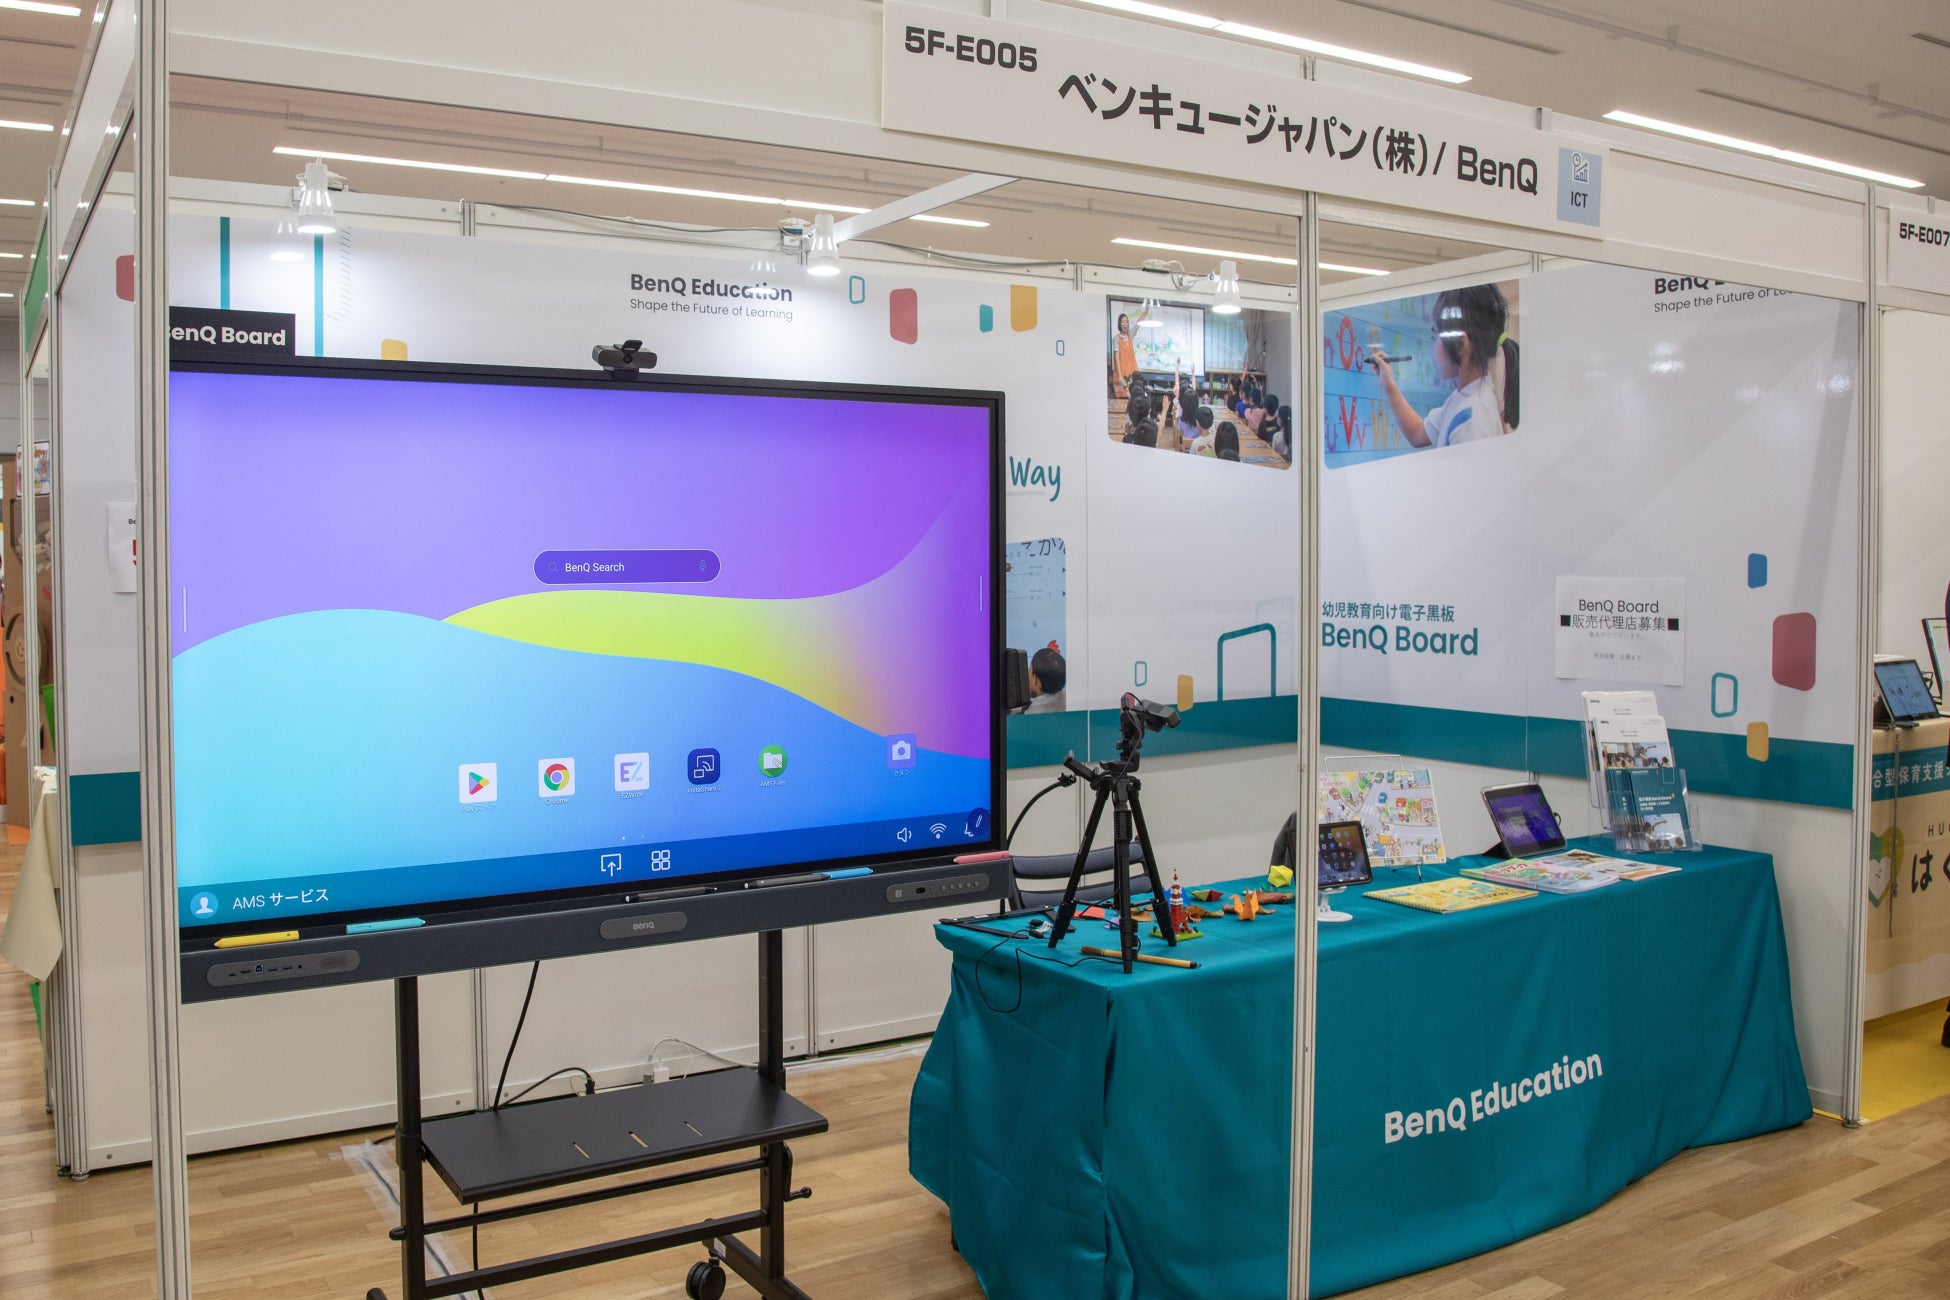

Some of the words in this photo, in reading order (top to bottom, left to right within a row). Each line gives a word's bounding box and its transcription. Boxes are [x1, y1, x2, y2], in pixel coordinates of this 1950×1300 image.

[904, 25, 1038, 73] 5F-E005
[1457, 144, 1539, 197] BenQ
[1570, 190, 1589, 208] ICT
[1899, 222, 1950, 247] 5F-E007
[630, 273, 687, 297] BenQ
[691, 278, 793, 302] Education
[630, 298, 668, 313] Shape
[671, 301, 691, 313] the
[693, 303, 729, 315] Future
[732, 305, 744, 316] of
[745, 307, 793, 323] Learning
[1654, 300, 1691, 313] Shape
[1694, 296, 1713, 308] the
[1716, 291, 1755, 304] Future
[168, 325, 217, 345] enQ
[221, 326, 286, 346] Board
[1009, 456, 1061, 502] Way
[565, 562, 590, 573] BenQ
[592, 562, 625, 572] Search
[1321, 601, 1455, 623] 幼児教育向け電子黒板
[1579, 599, 1614, 613] BenQ
[1617, 600, 1659, 613] Board
[1572, 614, 1667, 632] 販売代理店募集
[1321, 622, 1388, 655] BenQ
[1395, 625, 1479, 656] Board
[232, 895, 266, 910] AMS
[269, 888, 329, 906] サービス
[632, 921, 655, 930] BenQ
[1384, 1096, 1467, 1144] BenQ
[1470, 1053, 1603, 1122] Education
